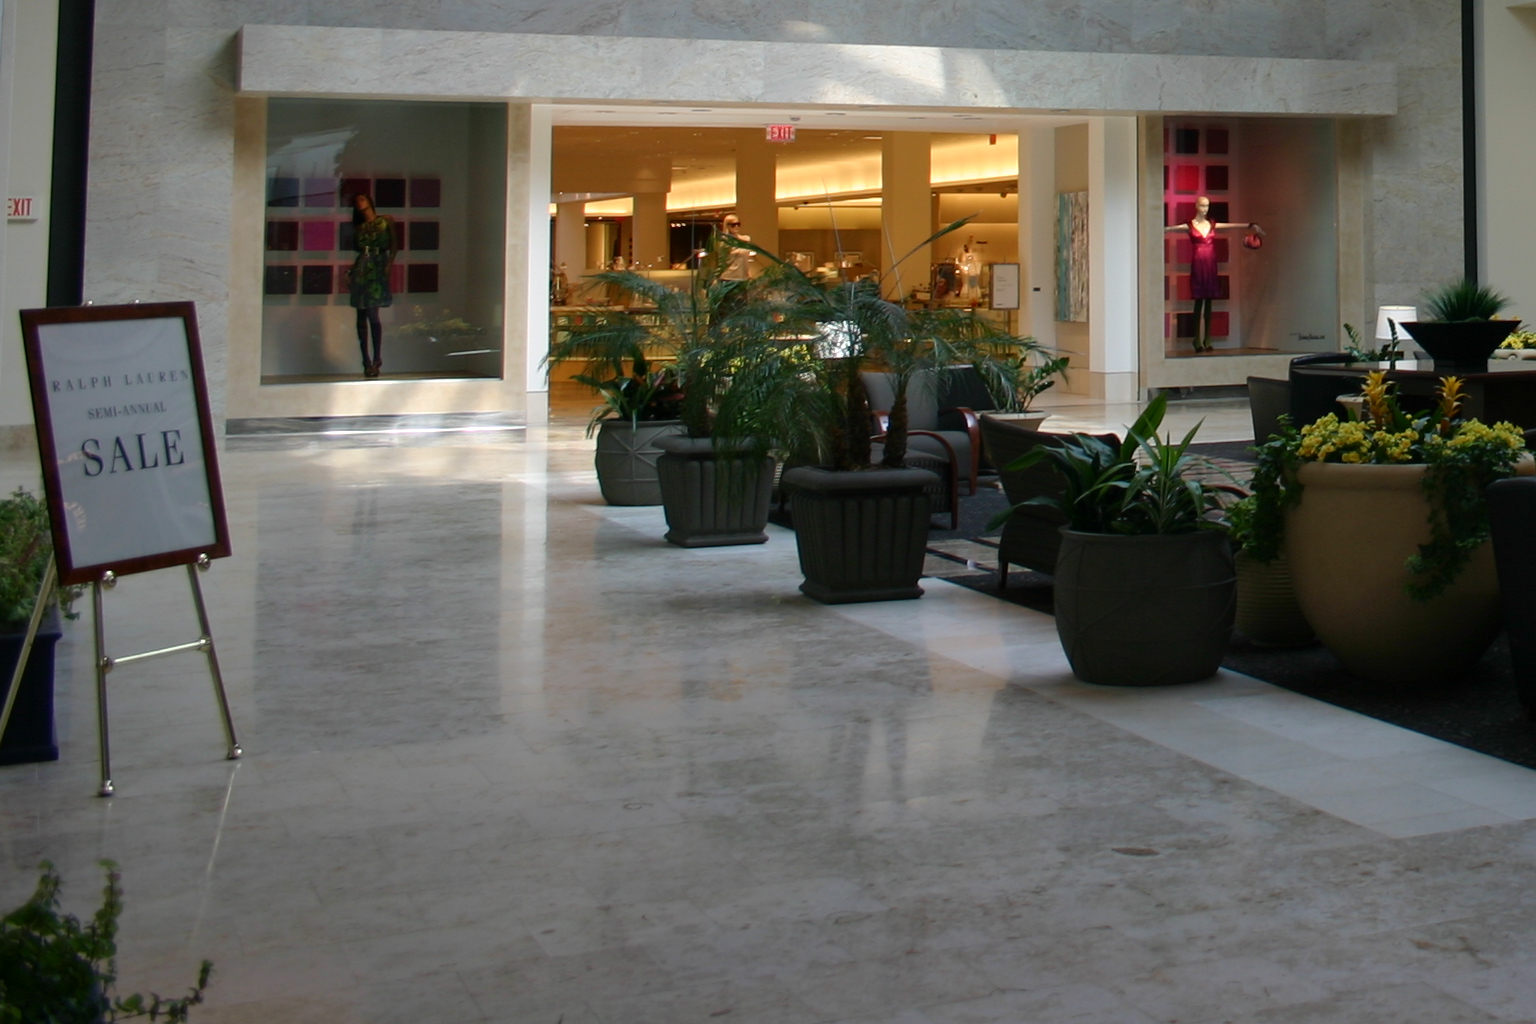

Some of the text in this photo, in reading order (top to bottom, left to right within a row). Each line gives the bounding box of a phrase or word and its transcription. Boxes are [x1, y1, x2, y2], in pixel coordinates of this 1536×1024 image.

[771, 126, 792, 139] EXIT
[52, 369, 189, 393] RALPH LAUREN
[87, 401, 168, 420] SEMI-ANNUAL
[81, 429, 185, 477] SALE
